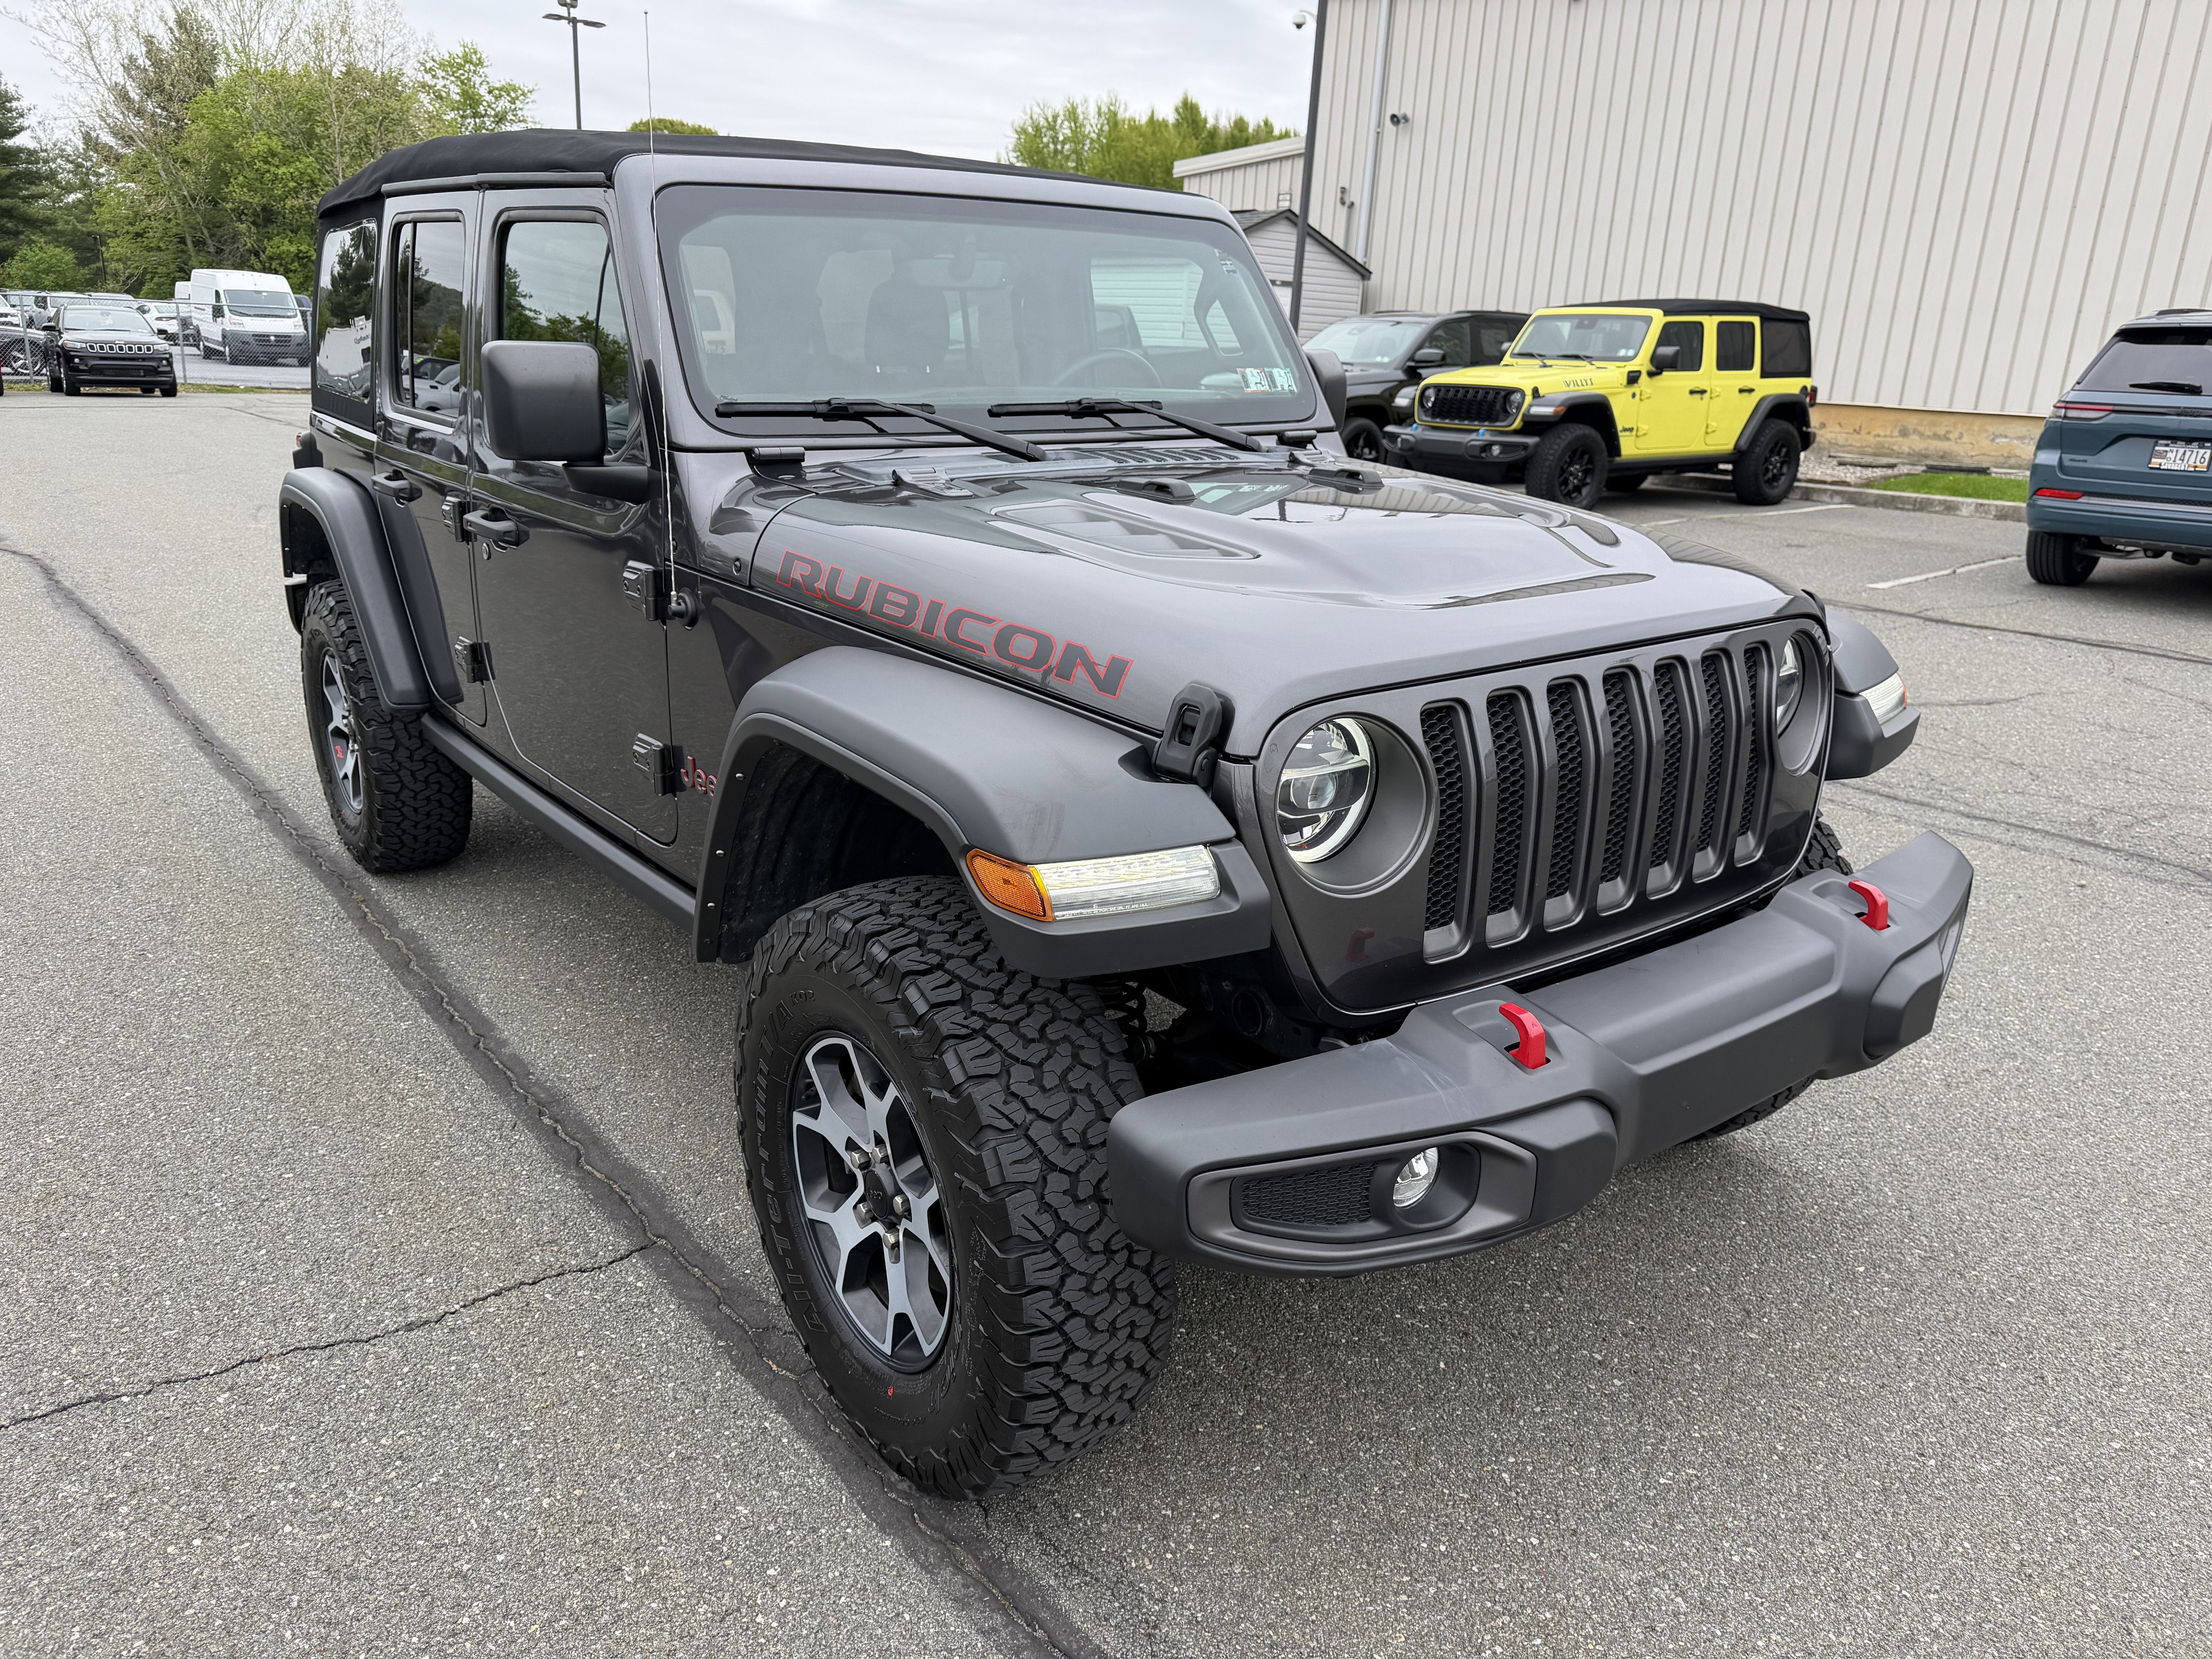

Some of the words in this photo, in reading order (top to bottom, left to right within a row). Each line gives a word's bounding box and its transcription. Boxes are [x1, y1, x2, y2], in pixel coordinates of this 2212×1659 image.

[1563, 378, 1594, 388] WILLYS
[2173, 449, 2207, 464] 14716
[776, 549, 1134, 700] RUBICON
[680, 756, 717, 797] Jee
[759, 1000, 793, 1057] T/A
